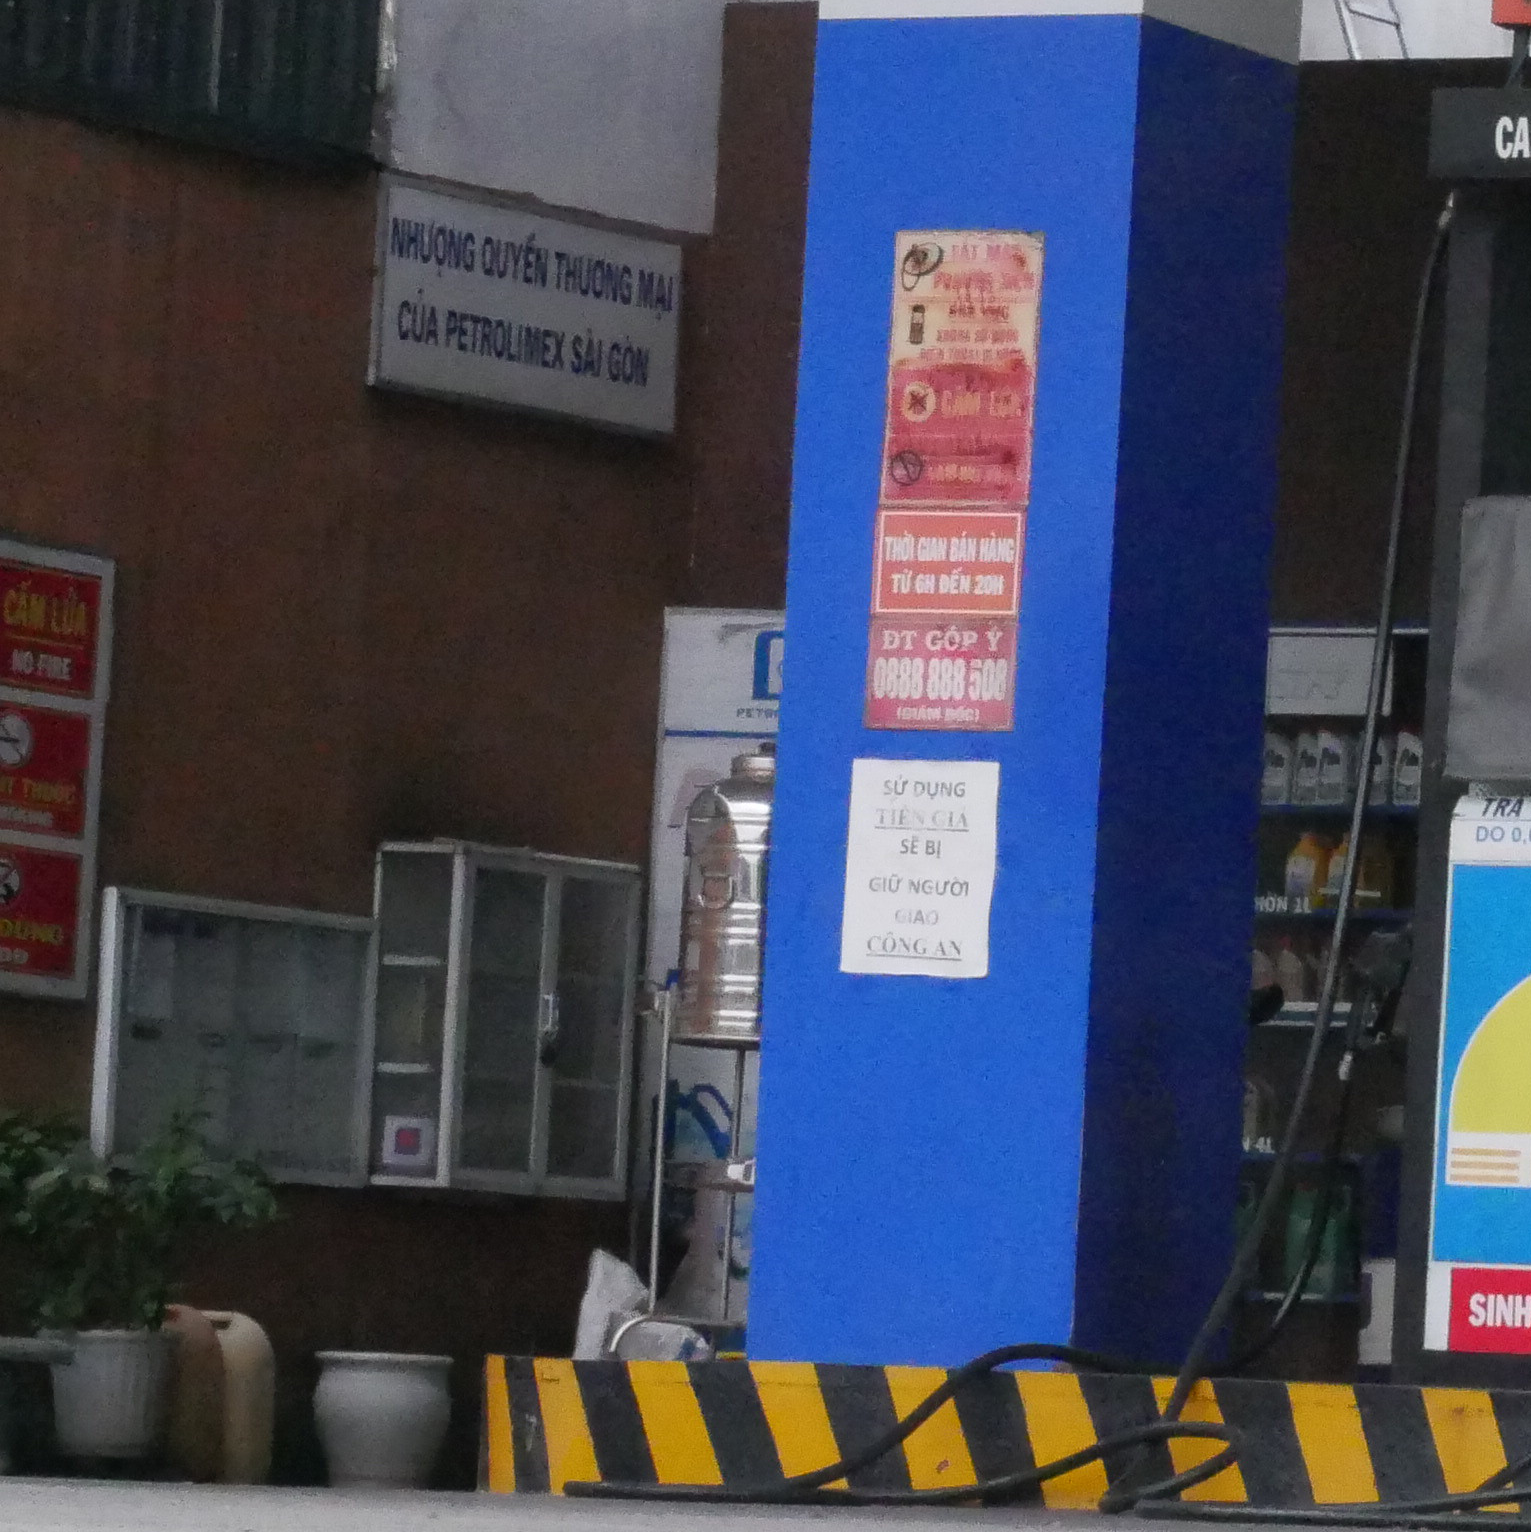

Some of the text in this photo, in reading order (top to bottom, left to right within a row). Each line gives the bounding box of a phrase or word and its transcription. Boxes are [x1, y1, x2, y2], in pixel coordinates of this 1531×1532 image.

[636, 268, 674, 320] MẠI
[397, 287, 439, 346] CỦA
[446, 309, 564, 369] PETROLIMEX
[571, 327, 604, 377] SÀI
[883, 630, 917, 651] ĐT
[914, 781, 966, 799] DỤNG
[1476, 826, 1505, 843] DO
[900, 836, 941, 858] SẼ BỊ
[869, 874, 969, 897] GIỮ NGƯỜI
[895, 909, 939, 925] GIAO
[867, 932, 962, 957] CÔNG AN
[1469, 1293, 1531, 1329] SINH
